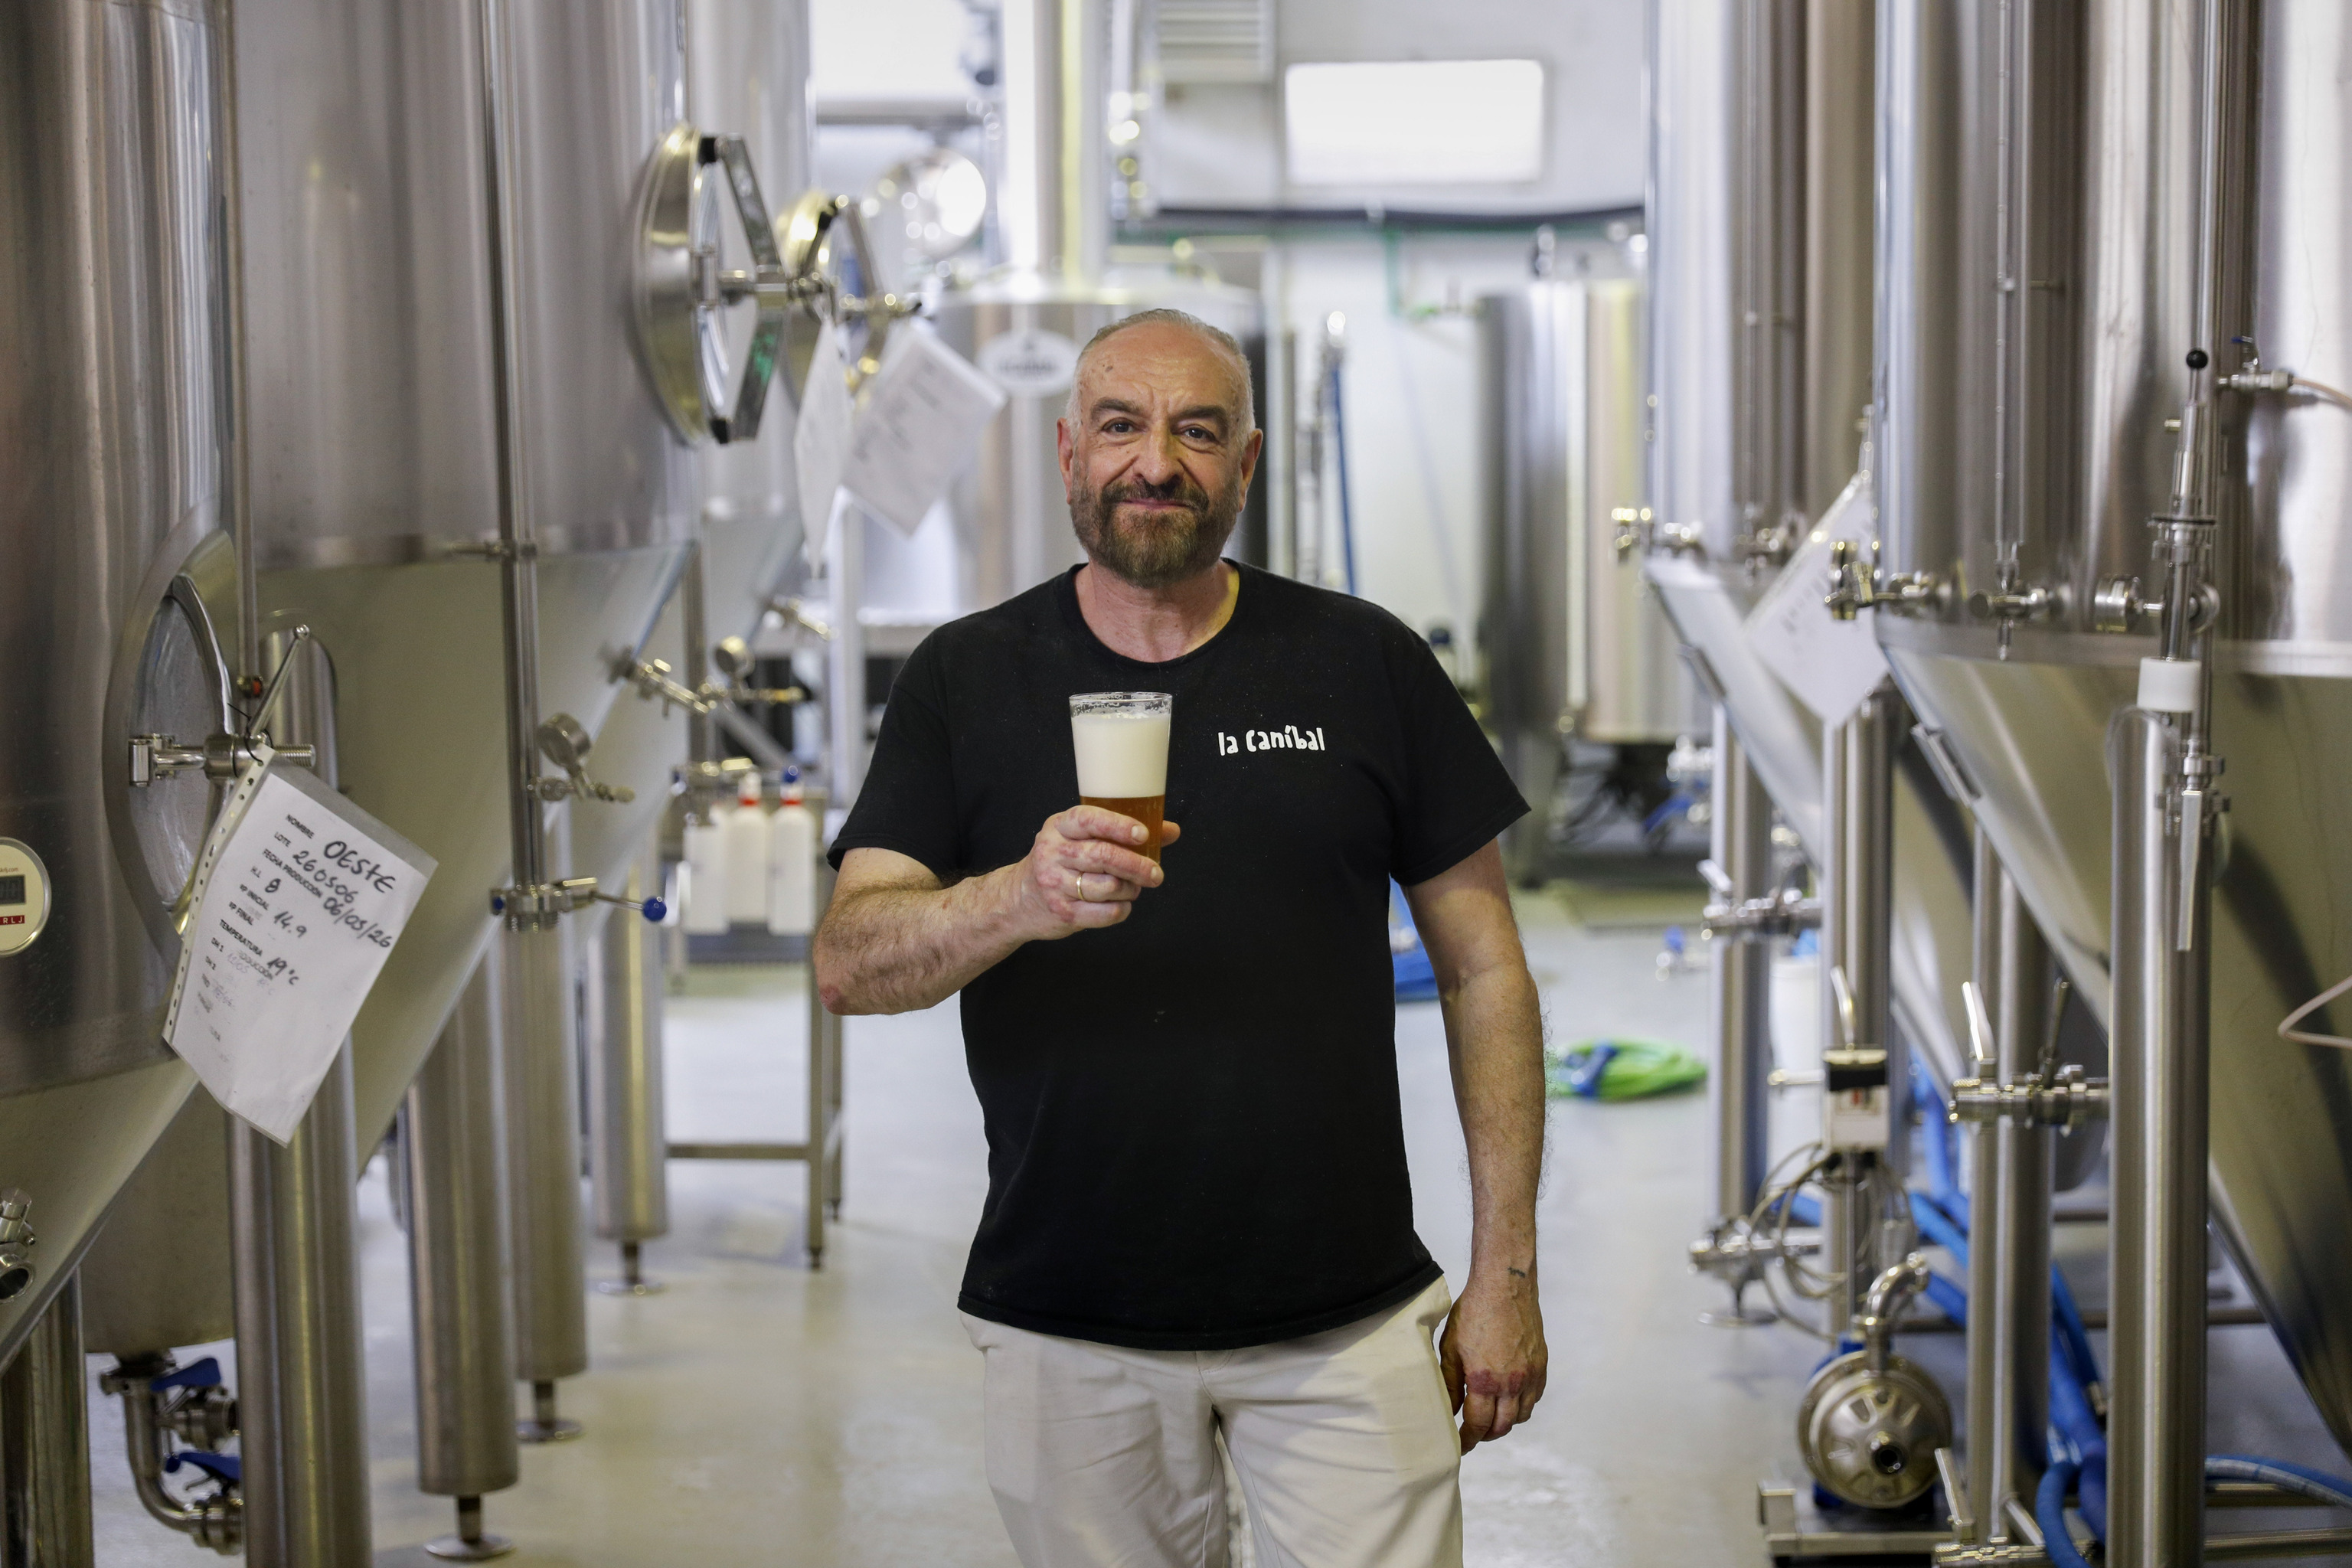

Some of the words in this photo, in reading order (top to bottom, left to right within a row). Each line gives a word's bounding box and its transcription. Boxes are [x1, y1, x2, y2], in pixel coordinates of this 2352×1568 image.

[1218, 732, 1239, 756] la
[286, 815, 314, 839] NOMBRE
[274, 832, 291, 847] LOTE
[263, 848, 283, 867] FECHA
[236, 907, 253, 925] FINAL
[220, 919, 263, 956] TEMPERATURA
